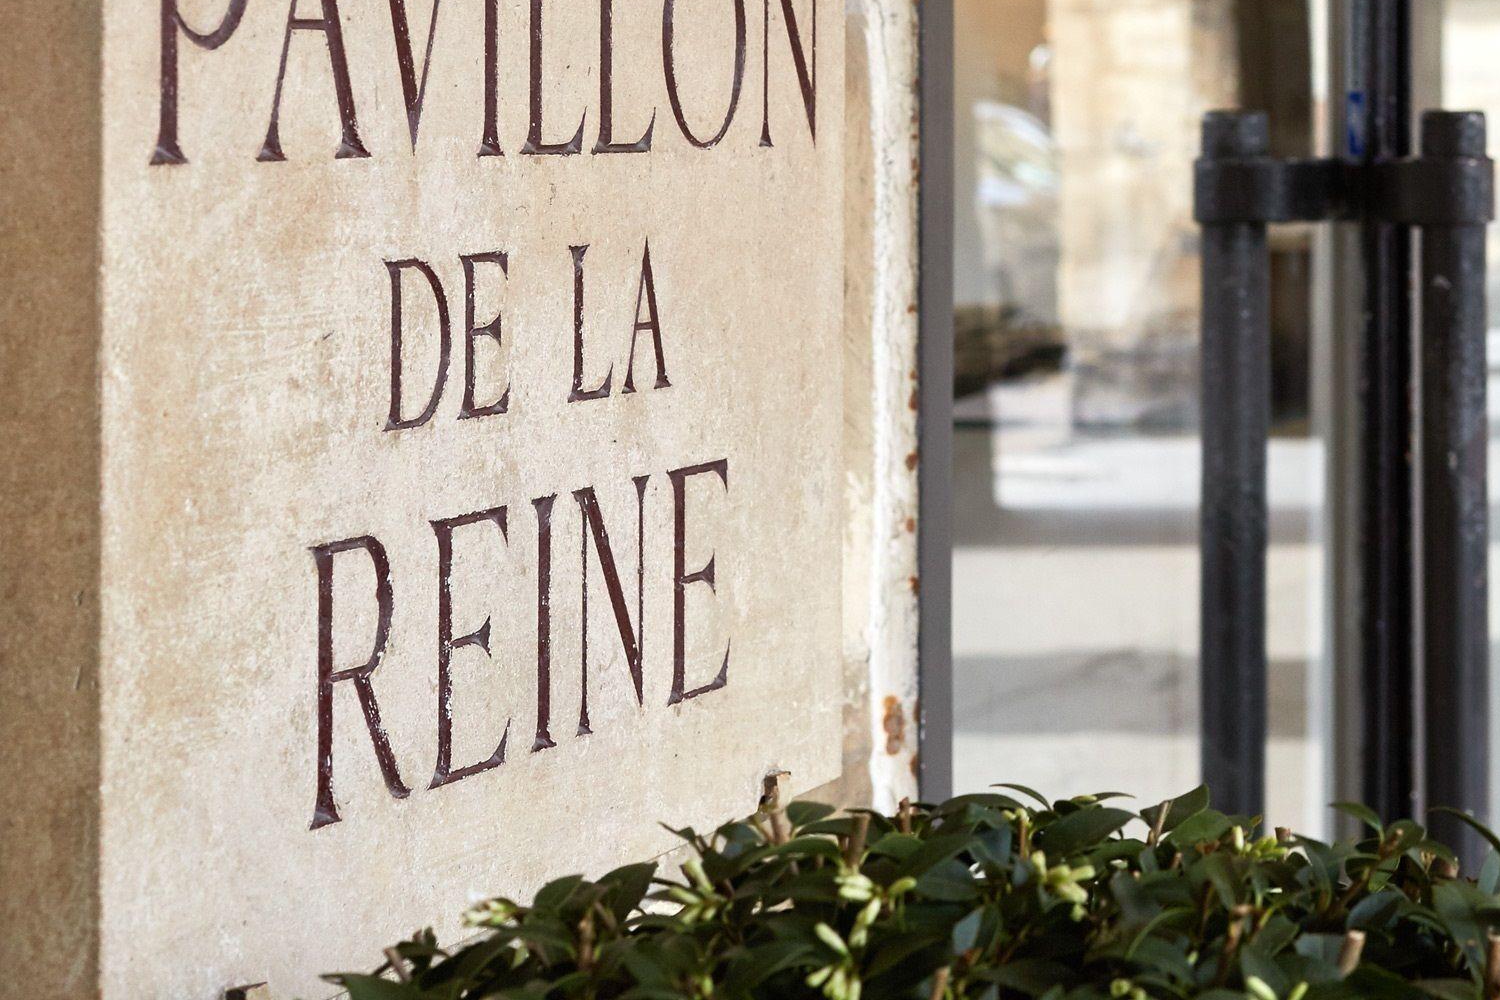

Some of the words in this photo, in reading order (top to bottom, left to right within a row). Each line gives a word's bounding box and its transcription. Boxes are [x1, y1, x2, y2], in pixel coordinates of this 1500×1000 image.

[381, 250, 510, 431] DE
[567, 236, 673, 402] LA
[308, 458, 731, 830] REINE
